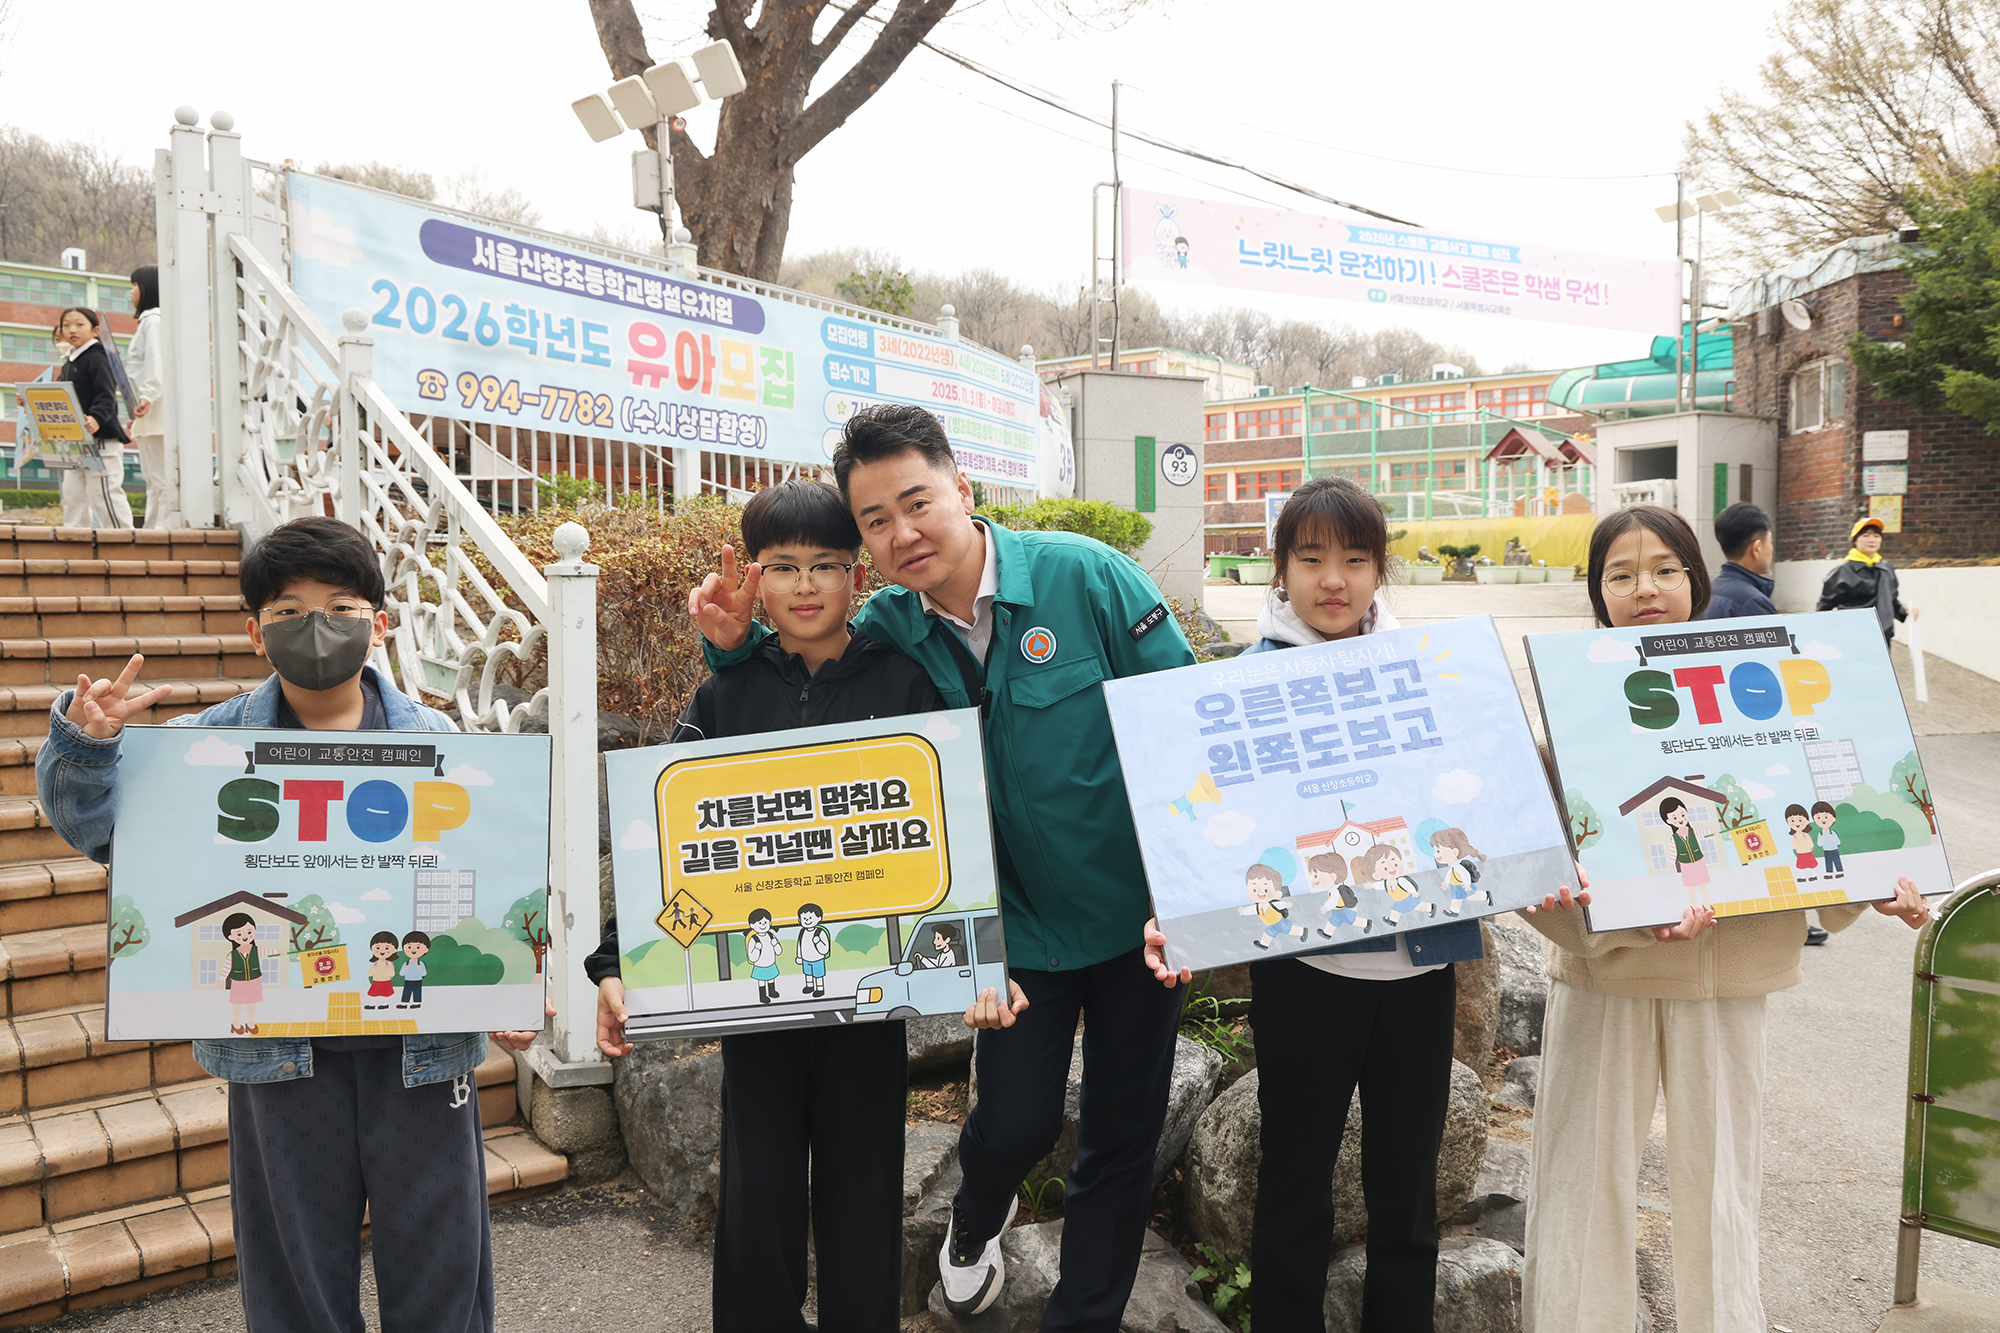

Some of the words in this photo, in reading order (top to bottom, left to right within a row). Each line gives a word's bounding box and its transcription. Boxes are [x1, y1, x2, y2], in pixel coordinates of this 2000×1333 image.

[1358, 230, 1396, 246] 2026년
[472, 235, 734, 326] 서울신창초등학교병설유치원
[1238, 238, 1335, 276] 느릿느릿
[1442, 263, 1520, 296] 스쿨존은
[1524, 273, 1561, 302] 학생
[371, 279, 612, 368] 2026학년도
[627, 322, 796, 410] 유아모집
[827, 323, 868, 349] 모집연령
[879, 335, 958, 369] 3세(2022년생),
[828, 360, 870, 386] 접수기간
[931, 381, 961, 401] 2025.
[457, 371, 614, 427] 994-7782
[621, 397, 767, 449] (수시상담환영)
[952, 449, 1028, 479] 과후특성화(체육,수학,영어)무료
[1171, 460, 1188, 473] 93
[1134, 622, 1148, 635] 서울
[1146, 608, 1163, 625] 도봉구
[1653, 638, 1689, 651] 어린이
[1693, 634, 1739, 649] 교통안전
[1743, 631, 1778, 645] 캠페인
[1211, 663, 1281, 689] 우리눈은
[1284, 653, 1336, 675] 자동차
[1337, 643, 1397, 668] 탐지기!
[1194, 659, 1428, 736] 오른쪽보고
[1623, 658, 1831, 730] STOP
[269, 747, 311, 760] 어린이
[318, 746, 374, 761] 교통안전
[381, 749, 422, 762] 캠페인
[1207, 706, 1443, 788] 왼쪽도보고
[1660, 737, 1706, 754] 횡단보도
[1708, 733, 1754, 750] 앞에서는
[1754, 732, 1767, 744] 한
[1768, 730, 1793, 744] 발짝
[1794, 727, 1821, 743] 뒤로!
[1302, 783, 1320, 794] 서울
[1321, 773, 1374, 791] 신창초등학교
[217, 778, 470, 843] STOP
[698, 788, 814, 830] 차를보면
[820, 779, 910, 816] 멈춰요
[244, 854, 300, 869] 횡단보도
[303, 854, 358, 869] 앞에서는
[361, 854, 375, 868] 한
[378, 854, 405, 869] 발짝
[408, 855, 438, 869] 뒤로!
[681, 840, 740, 874] 길을
[746, 829, 834, 867] 건널땐
[840, 819, 931, 856] 살펴요
[734, 882, 753, 893] 서울
[755, 875, 812, 891] 신창초등학교
[815, 871, 853, 885] 교통안전
[855, 868, 885, 881] 캠페인
